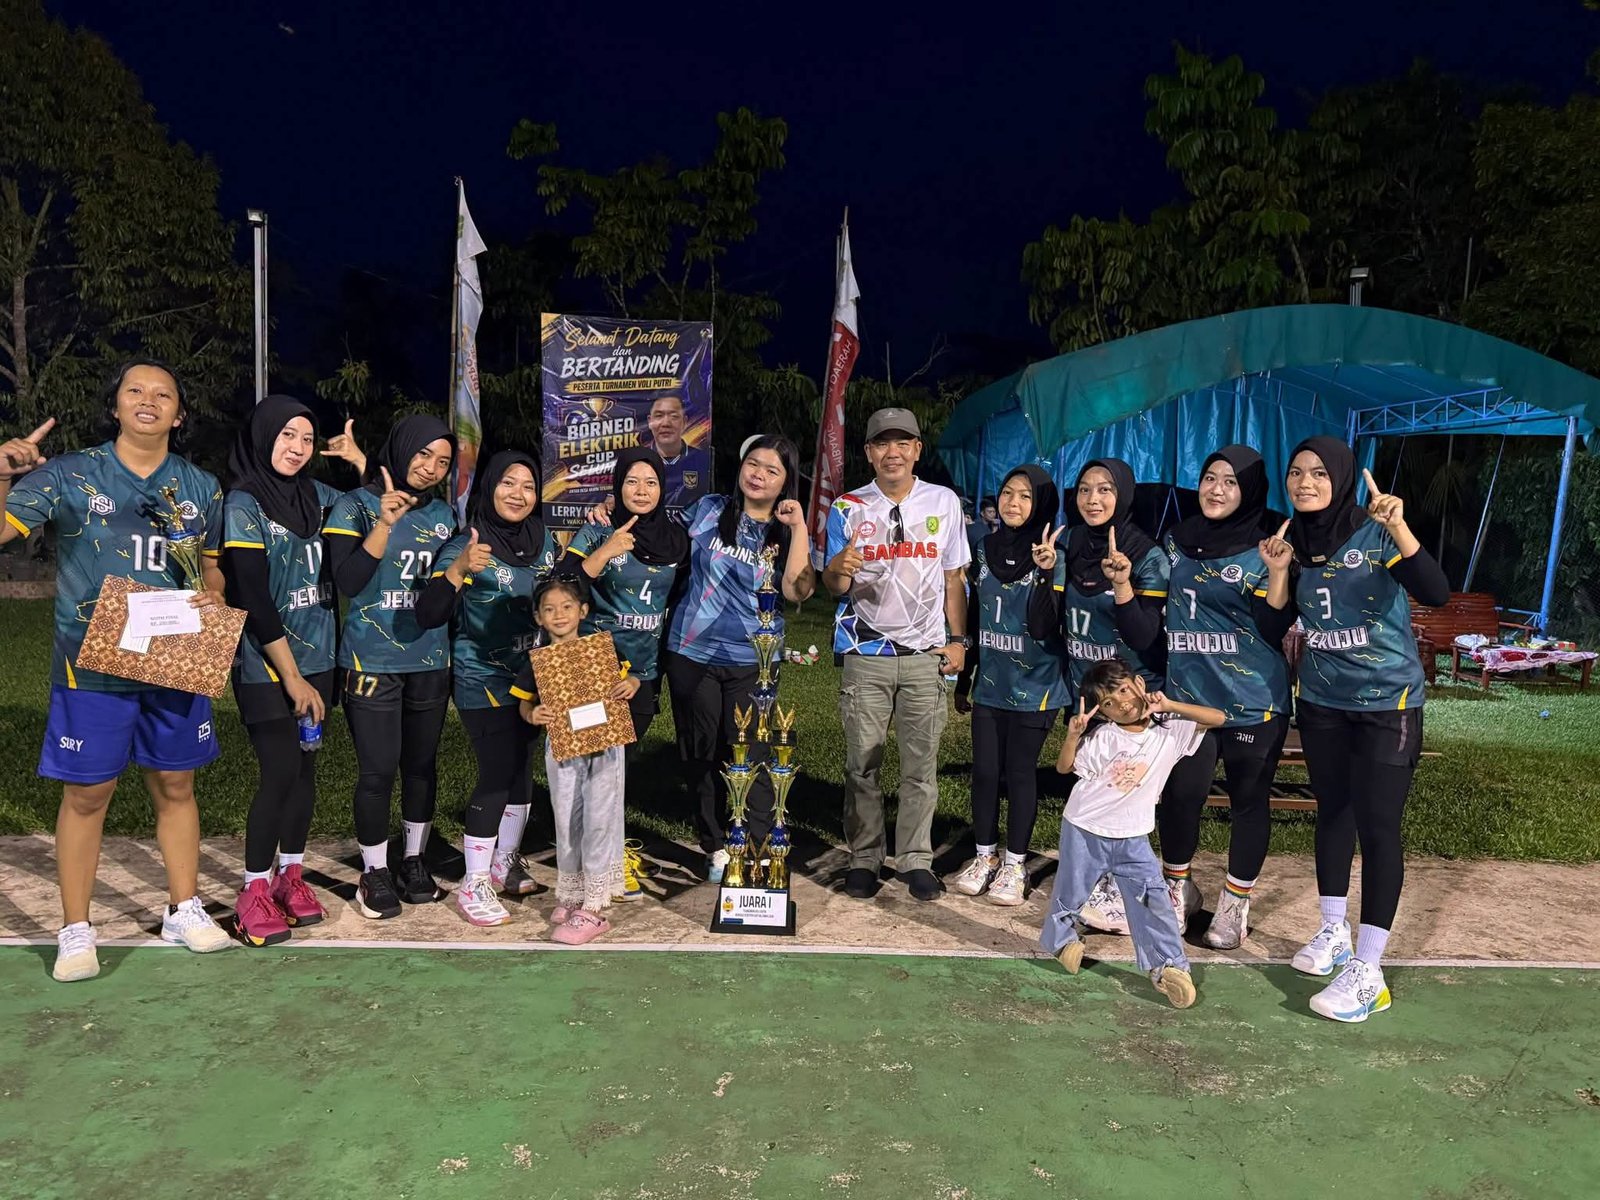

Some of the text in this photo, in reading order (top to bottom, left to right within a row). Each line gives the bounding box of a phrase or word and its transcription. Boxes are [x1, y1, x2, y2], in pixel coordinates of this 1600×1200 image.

[564, 326, 679, 352] Selamat Datang
[612, 345, 633, 356] dan
[560, 353, 680, 379] BERTANDING
[573, 379, 672, 392] PESERTA TURNAMEN VOLI PUTRI
[567, 417, 635, 441] BORNEO
[559, 432, 641, 459] ELEKTRIK
[586, 451, 615, 464] CUP
[552, 506, 582, 517] LERRY
[131, 534, 167, 571] 10
[863, 541, 938, 561] SAMBAS
[400, 551, 432, 580] 20
[639, 580, 652, 605] 4
[1183, 588, 1196, 619] 7
[1316, 588, 1332, 619] 3
[994, 596, 1003, 624] 1
[1071, 607, 1091, 637] 17
[1167, 632, 1238, 654] JERUJU
[354, 674, 378, 697] 17
[739, 894, 767, 909] JUARA
